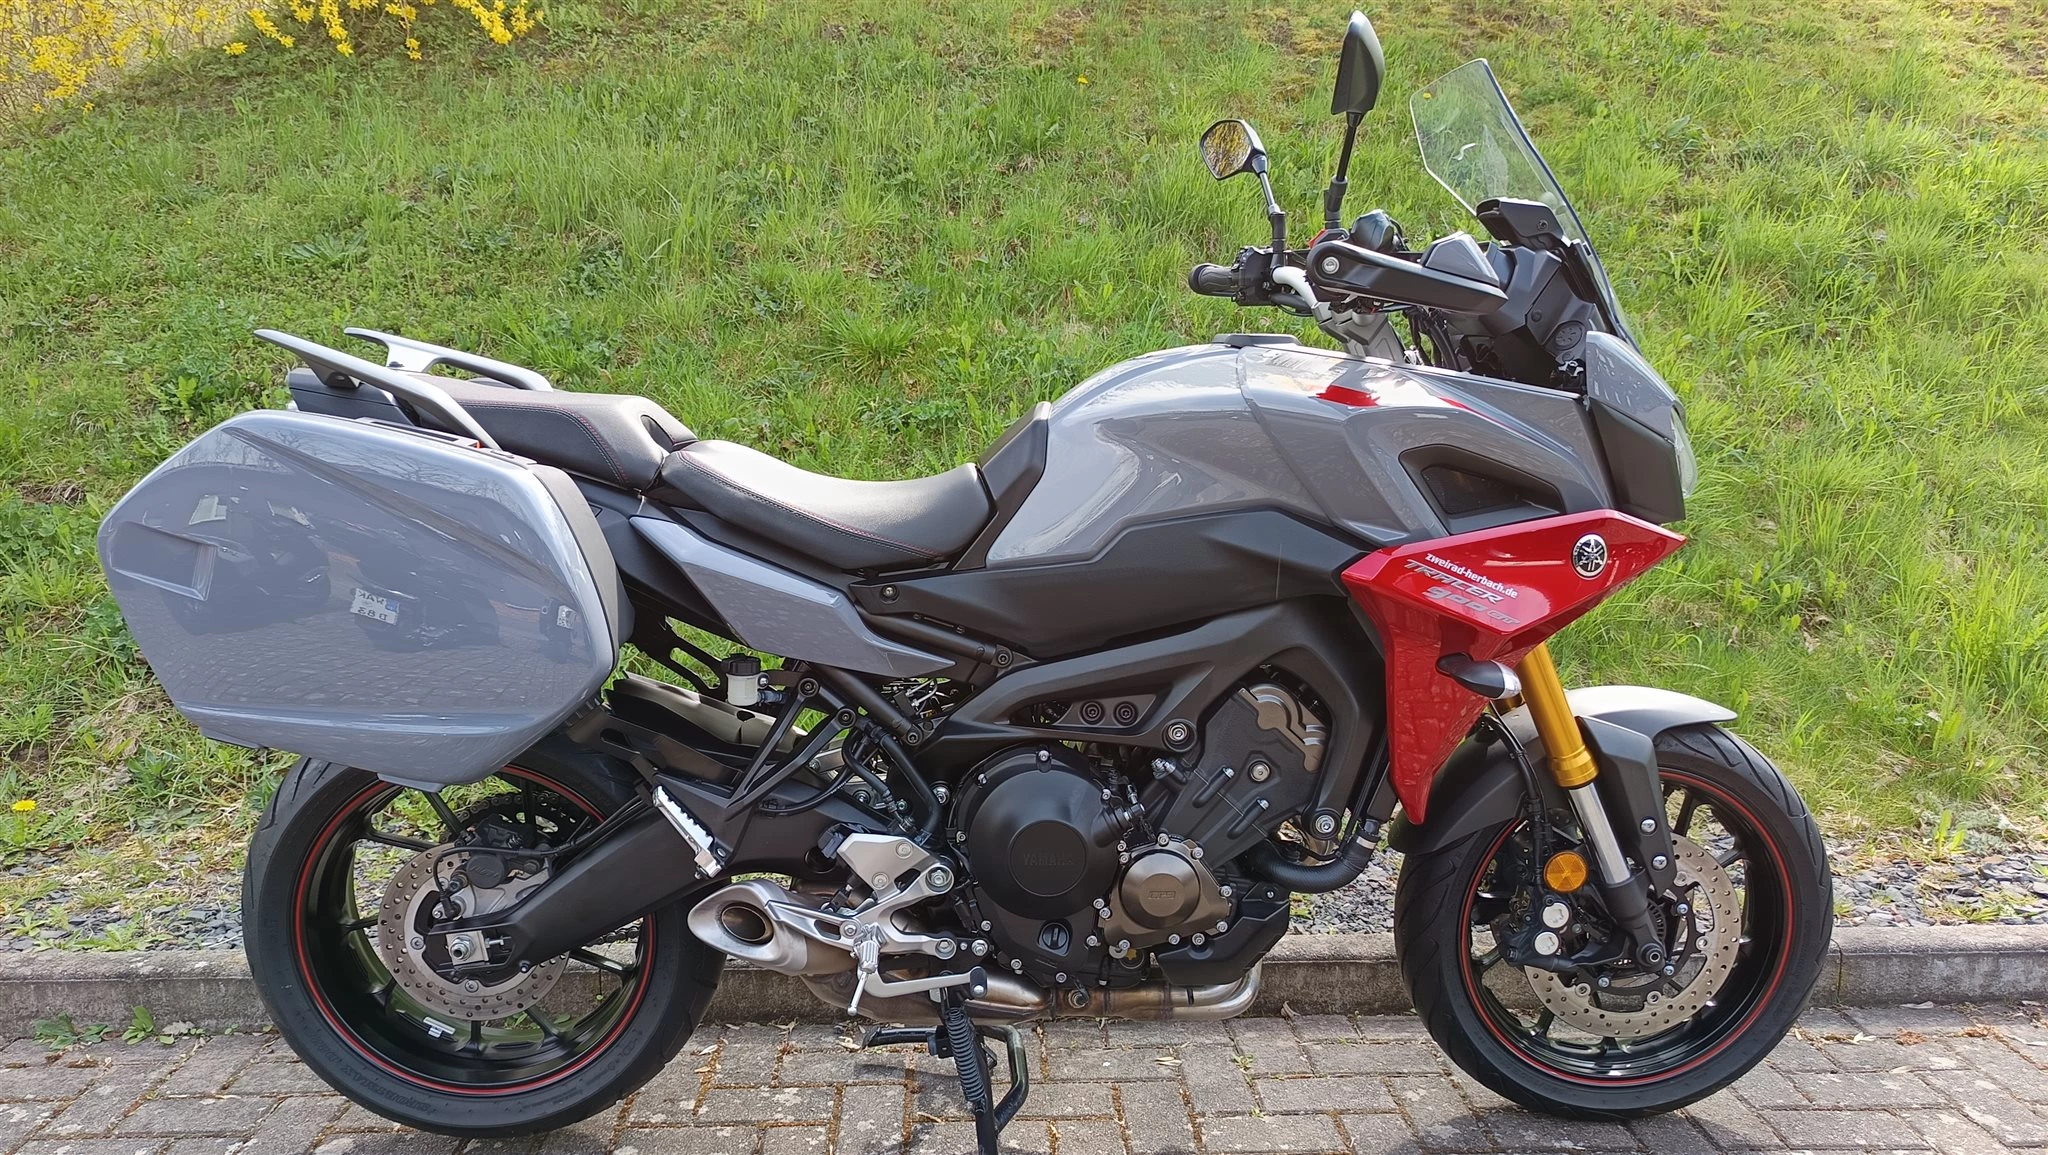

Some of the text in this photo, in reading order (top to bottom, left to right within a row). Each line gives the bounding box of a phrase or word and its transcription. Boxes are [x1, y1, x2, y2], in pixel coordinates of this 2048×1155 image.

[1404, 559, 1504, 605] TRACER
[1422, 586, 1488, 612] 900
[1425, 553, 1518, 599] zweirad-herbach.de
